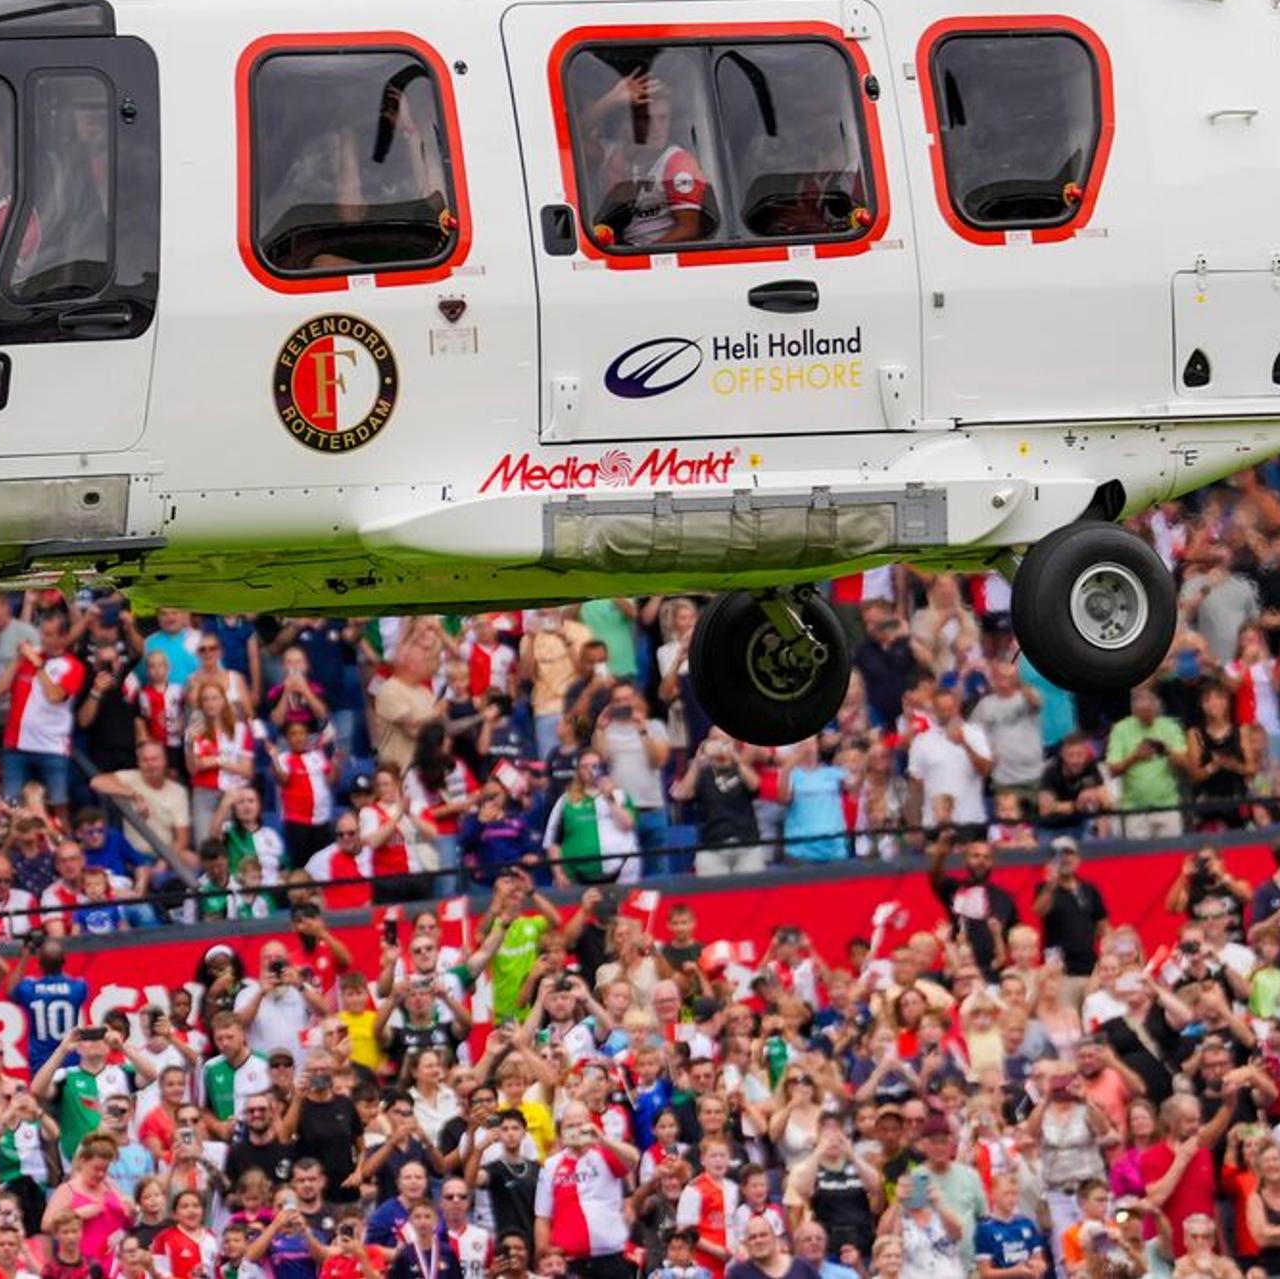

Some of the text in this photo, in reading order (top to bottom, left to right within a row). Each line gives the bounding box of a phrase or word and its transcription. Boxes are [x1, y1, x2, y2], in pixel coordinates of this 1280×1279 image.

[280, 318, 389, 369] FEYENOORD
[713, 326, 863, 361] Heli Holland
[712, 360, 863, 395] OFFSHORE
[282, 399, 392, 450] ROTTERDAM
[30, 999, 73, 1041] 10
